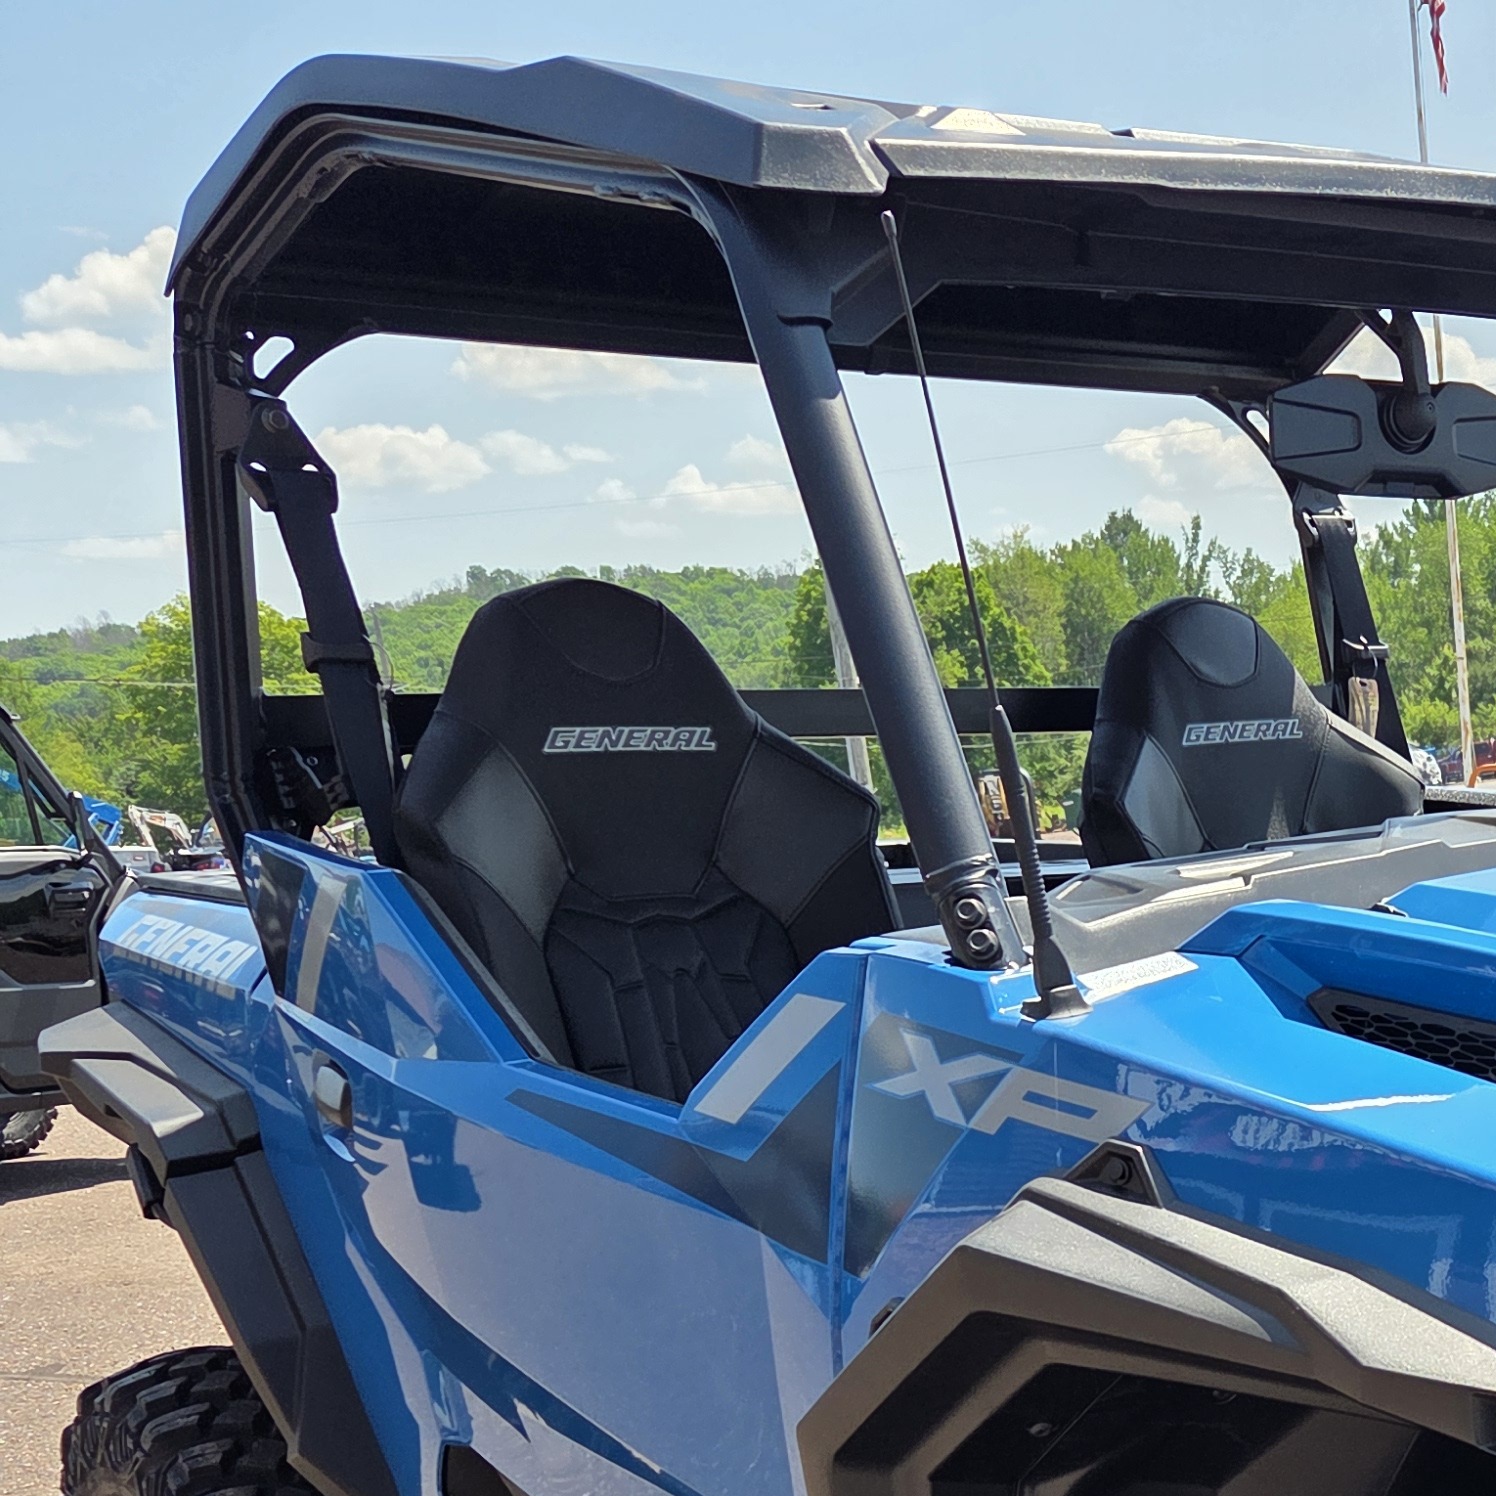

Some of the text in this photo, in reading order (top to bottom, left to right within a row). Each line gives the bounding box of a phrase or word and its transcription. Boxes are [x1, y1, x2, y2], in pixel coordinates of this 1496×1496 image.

[543, 726, 717, 753] GENERAL
[1182, 718, 1303, 746] GENERAL
[107, 914, 259, 1000] GENERAL
[868, 1029, 1152, 1144] XP
